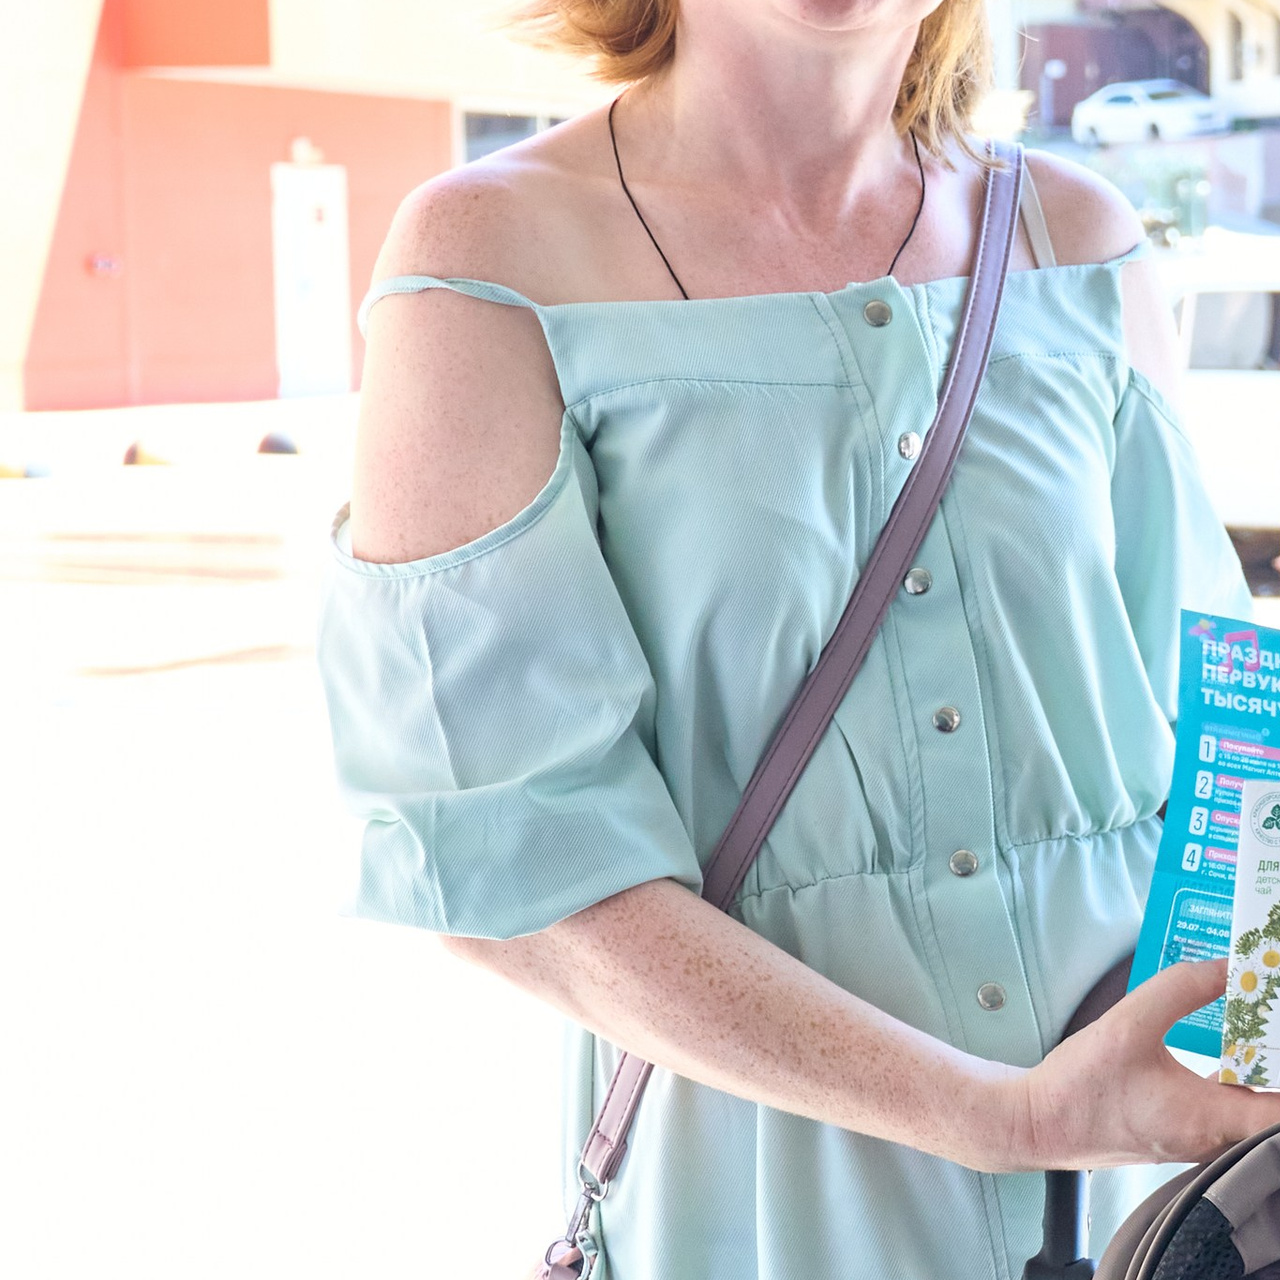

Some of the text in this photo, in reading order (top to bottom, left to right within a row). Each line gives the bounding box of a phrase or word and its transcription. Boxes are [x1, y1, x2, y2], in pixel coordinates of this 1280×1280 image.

[1204, 741, 1210, 758] 1
[1223, 741, 1264, 756] Покупайте
[1199, 776, 1208, 794] 2
[1193, 812, 1203, 831] 3
[1186, 849, 1196, 867] 4
[1255, 886, 1272, 895] чай
[1176, 921, 1199, 933] 29.07
[1206, 927, 1230, 938] 04.08
